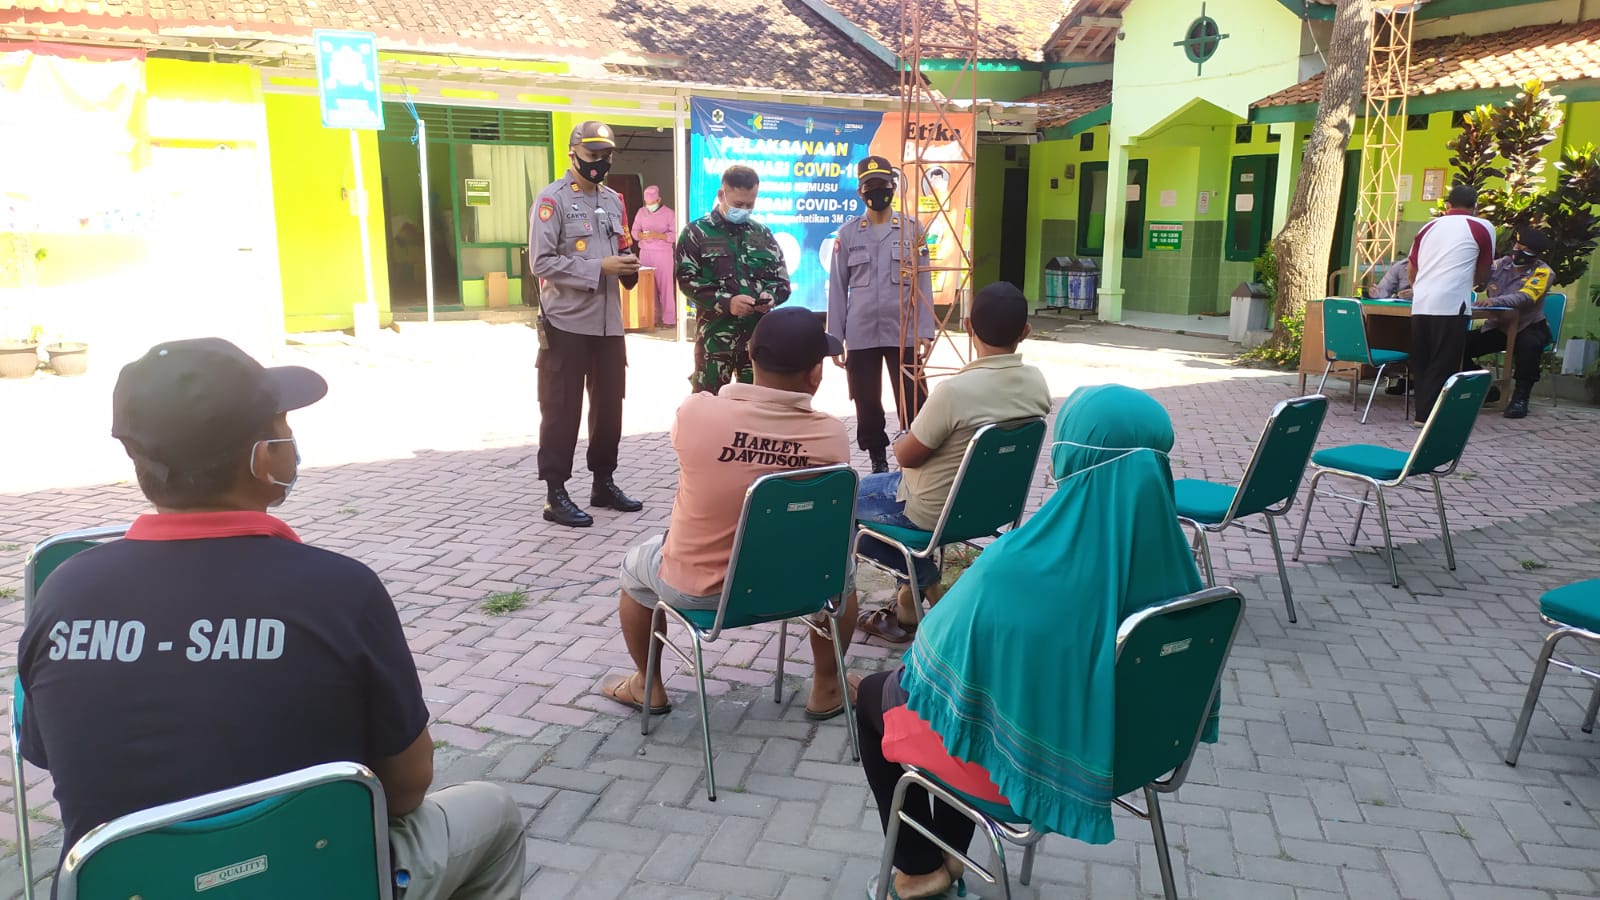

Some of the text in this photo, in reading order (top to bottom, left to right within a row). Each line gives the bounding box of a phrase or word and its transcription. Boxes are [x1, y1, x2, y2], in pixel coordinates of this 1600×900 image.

[721, 136, 848, 156] PELAKSANAAN
[796, 199, 858, 211] COVID-19
[831, 214, 844, 223] 3M
[49, 619, 145, 663] SENO
[186, 618, 286, 662] SAID
[219, 860, 262, 881] QUALITY
